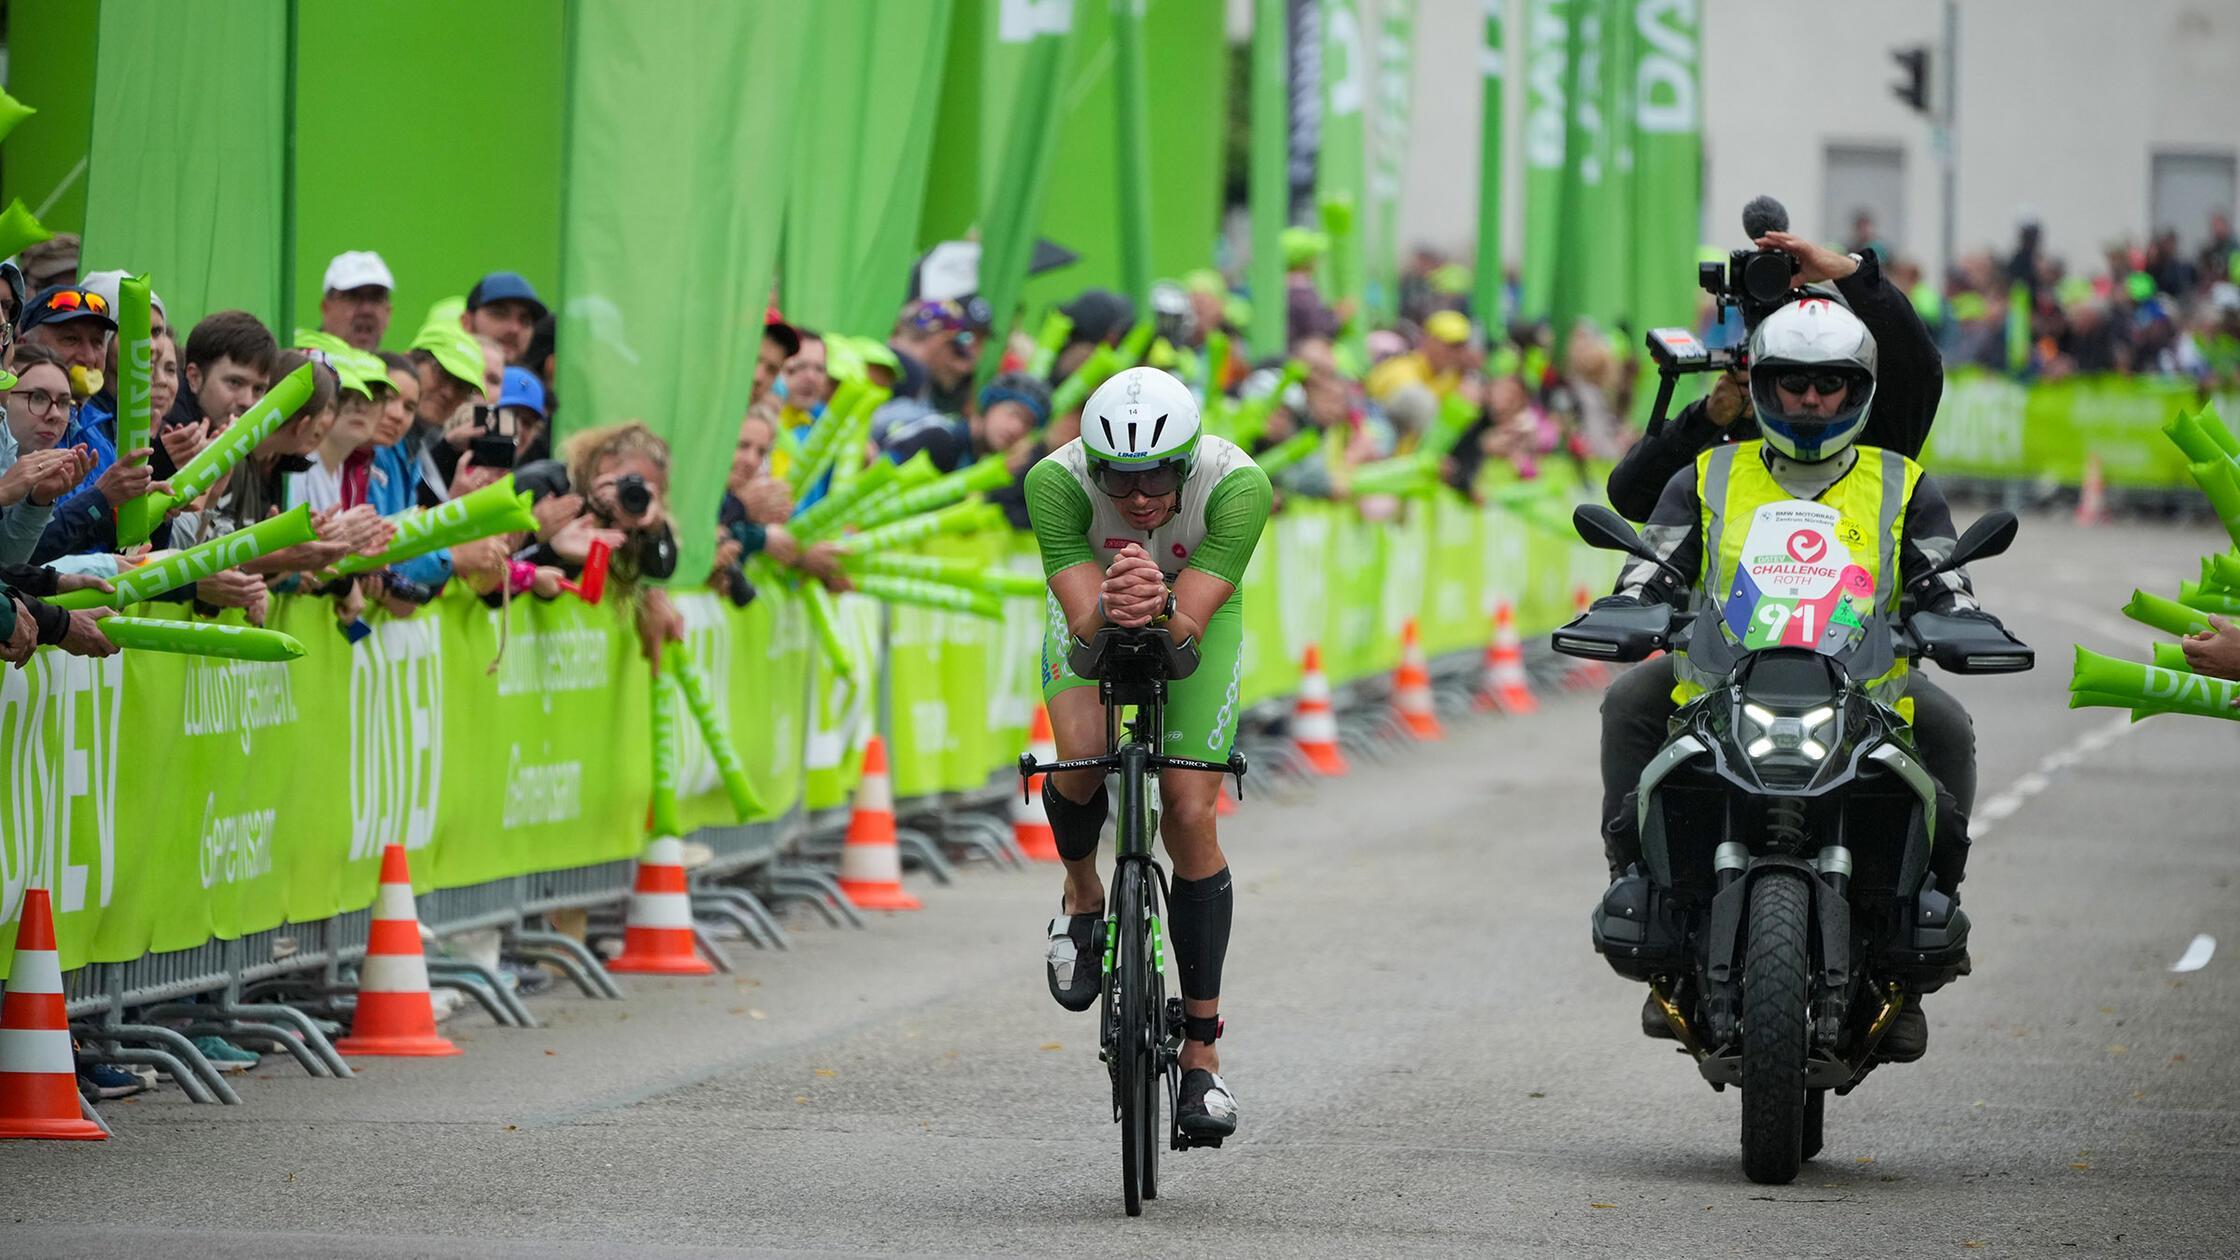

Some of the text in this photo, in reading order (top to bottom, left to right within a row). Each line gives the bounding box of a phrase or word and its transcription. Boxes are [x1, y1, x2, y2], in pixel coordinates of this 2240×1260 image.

[130, 340, 151, 452] DATE
[1796, 511, 1835, 521] MOTORRAD
[115, 532, 260, 610] DATEV
[1752, 564, 1837, 578] CHALLENGE
[1773, 575, 1812, 585] ROTH
[1758, 603, 1815, 642] 91
[2143, 664, 2233, 711] DAT
[1058, 759, 1099, 768] STORCK
[1168, 758, 1208, 768] STORCK
